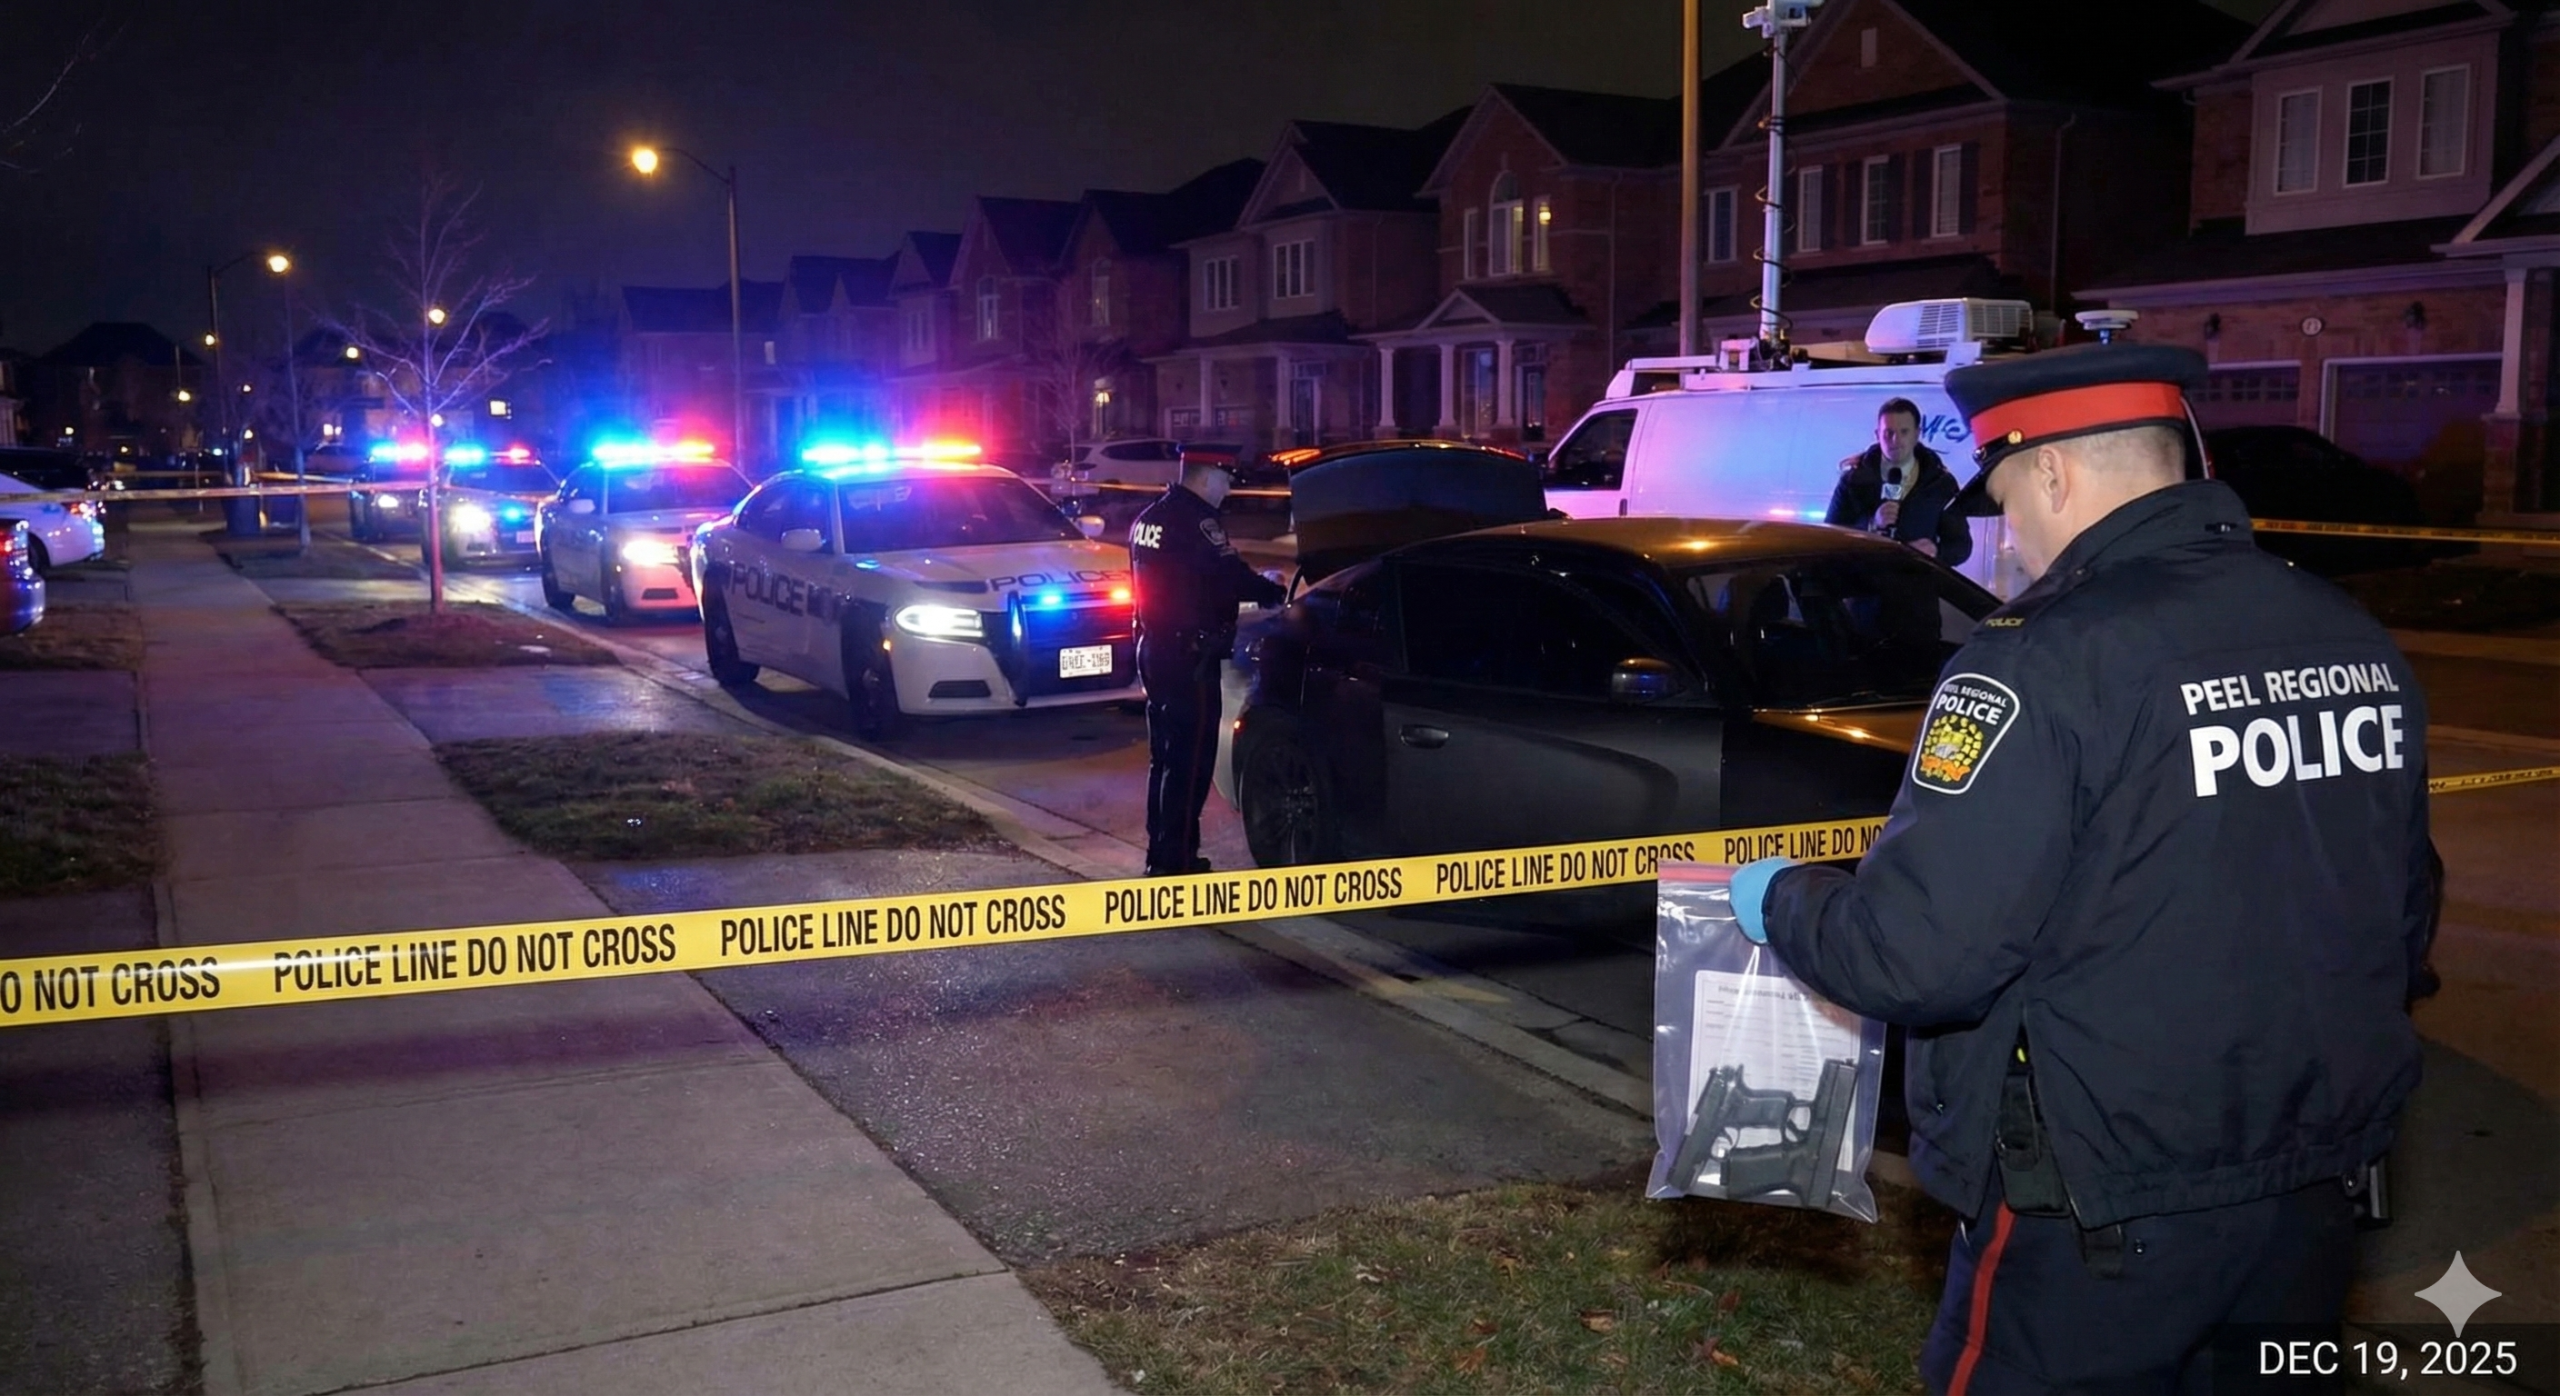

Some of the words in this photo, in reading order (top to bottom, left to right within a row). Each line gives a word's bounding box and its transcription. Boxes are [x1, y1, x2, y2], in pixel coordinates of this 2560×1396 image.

[1133, 520, 1163, 549] OLICE
[732, 562, 805, 617] POLICE
[991, 570, 1128, 591] POLICE
[1936, 693, 2003, 725] POLICE
[2180, 674, 2261, 715] PEEL
[2263, 663, 2399, 703] REGIONAL
[2189, 705, 2404, 797] POLICE
[1436, 858, 1505, 894] POLICE
[1512, 854, 1553, 887] LINE
[1560, 851, 1585, 882] DO
[1592, 847, 1628, 879] NOT
[1635, 841, 1695, 875] CROSS
[1724, 833, 1784, 865] POLICE
[1790, 830, 1826, 859] LINE
[1832, 827, 1854, 855] DO
[1860, 825, 1883, 853] NO
[1105, 885, 1184, 924] POLICE
[1193, 881, 1241, 917] LINE
[1249, 877, 1278, 912] DO
[1285, 874, 1326, 908] NOT
[1334, 867, 1402, 905] CROSS
[721, 914, 813, 956] POLICE
[822, 909, 878, 948] LINE
[887, 905, 921, 943] DO
[930, 902, 977, 939] NOT
[986, 894, 1066, 934] CROSS
[274, 945, 381, 992] POLICE
[392, 940, 457, 983] LINE
[468, 937, 507, 977] DO
[517, 931, 574, 973] NOT
[583, 923, 676, 968] CROSS
[0, 971, 22, 1014] O
[34, 966, 99, 1011] NOT
[112, 957, 220, 1005] CROSS
